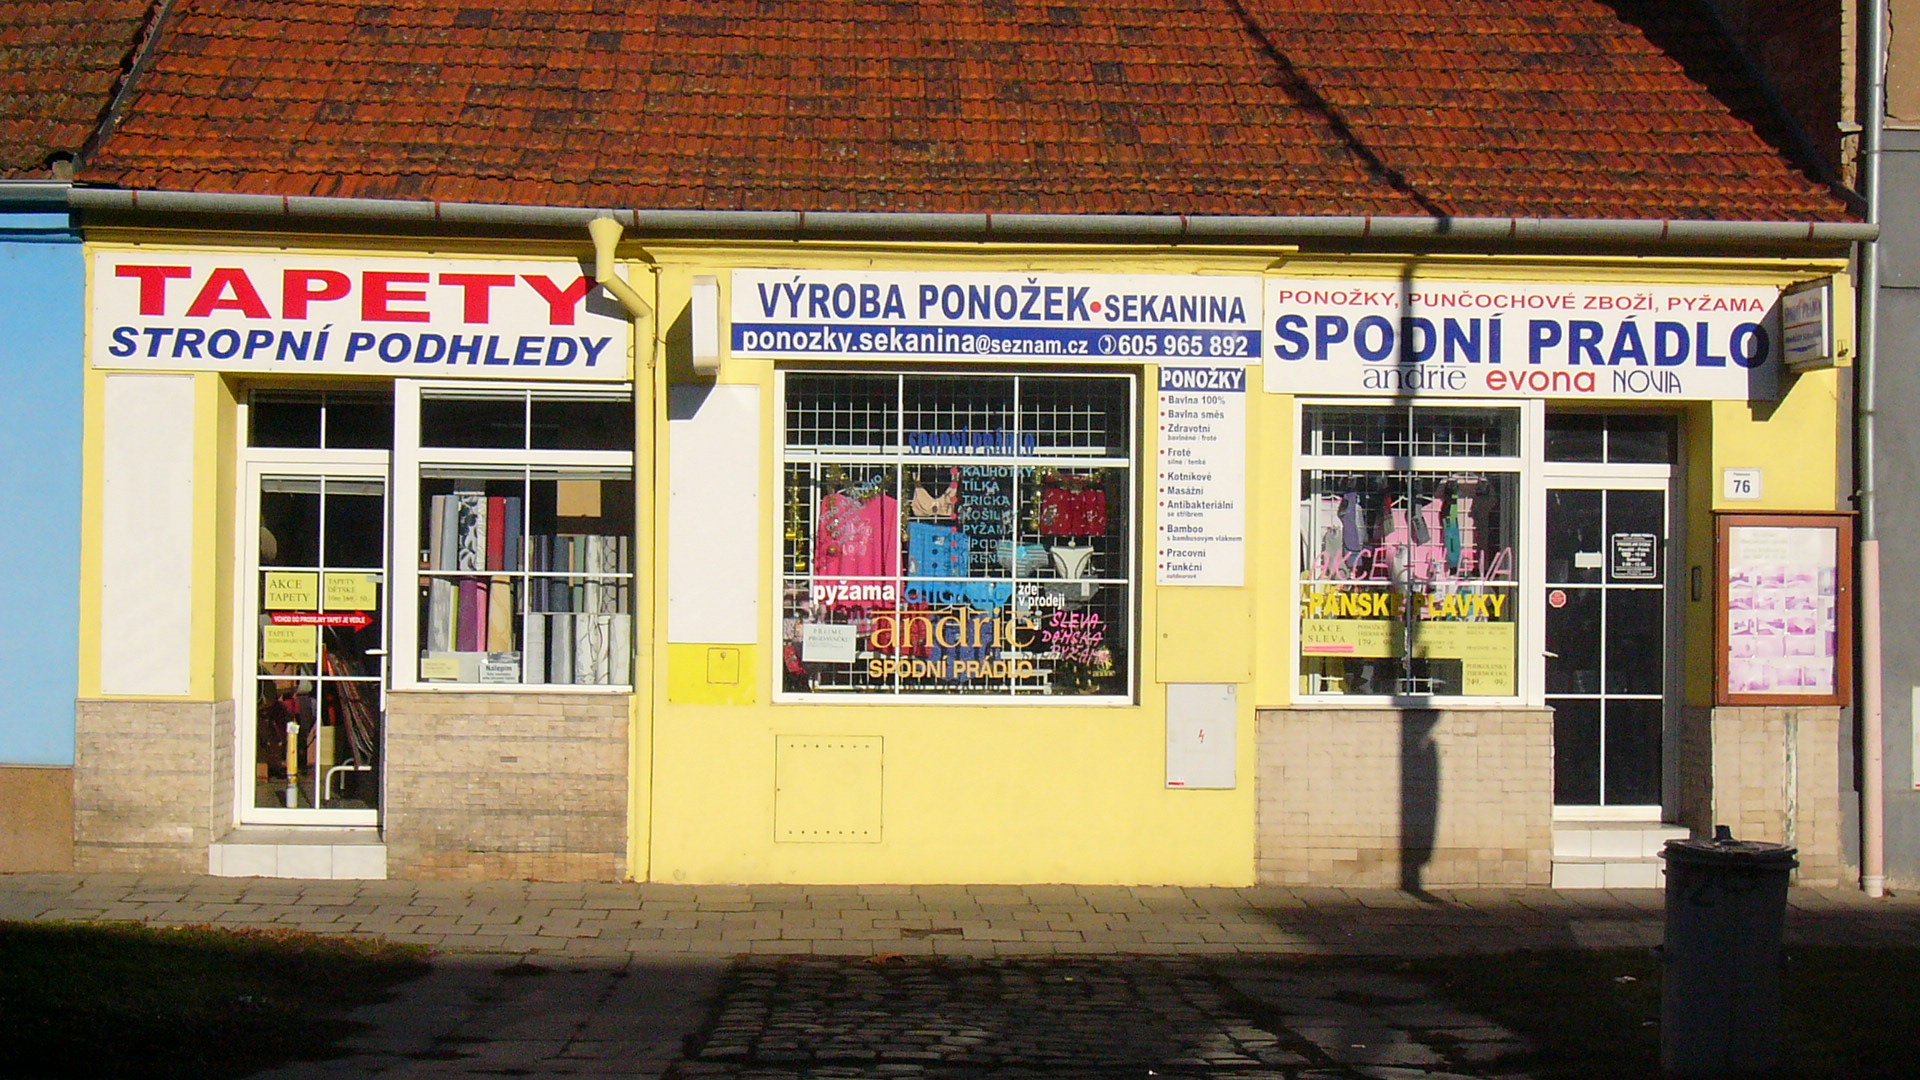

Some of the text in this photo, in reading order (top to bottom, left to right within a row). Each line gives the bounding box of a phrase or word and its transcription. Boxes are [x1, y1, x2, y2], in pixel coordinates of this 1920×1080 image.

[115, 264, 599, 326] TAPETY
[757, 275, 1247, 324] VÝROBA PONOŽEK SEKANINA
[1279, 288, 1400, 310] PONOŽKY,
[1407, 289, 1576, 310] PUNČOCHOVÉ
[1583, 291, 1660, 313] ZBOŽÍ,
[1668, 293, 1765, 313] PYŽAMA
[109, 324, 612, 367] STROPNÍ PODHLEDY
[743, 325, 1249, 358] ponozky.sekanina@seznam.cz 605 965 892
[1274, 313, 1770, 369] SPODNÍ PRÁDLO
[1161, 366, 1243, 389] PONOŽKY
[1362, 364, 1683, 395] andrie evona NOVIA
[1168, 395, 1226, 405] Bavlna 100%
[1168, 409, 1225, 419] Bavlna směs
[1168, 423, 1211, 433] Zdravotní
[1167, 447, 1192, 457] Froté
[1167, 471, 1212, 481] Kotníkové
[962, 479, 1000, 491] TÍLKA
[1167, 485, 1204, 495] Masážní
[1733, 479, 1751, 493] 76
[962, 493, 1010, 506] TRIČKA
[1167, 500, 1234, 510] Antibakteriální
[1167, 524, 1204, 533] Bamboo
[1166, 548, 1206, 558] Pracovní
[1166, 561, 1203, 571] Funkční
[1309, 549, 1389, 584] AKCE
[269, 579, 303, 589] AKCE
[1018, 582, 1037, 596] zde
[270, 592, 310, 602] TAPETY
[813, 579, 895, 606] pyžama
[1027, 593, 1065, 610] prodeji
[870, 606, 1037, 649] andrie
[1310, 624, 1342, 632] AKCE
[1307, 635, 1346, 643] SLEVA
[869, 655, 1034, 679] SPODNÍ PRÁDLO
